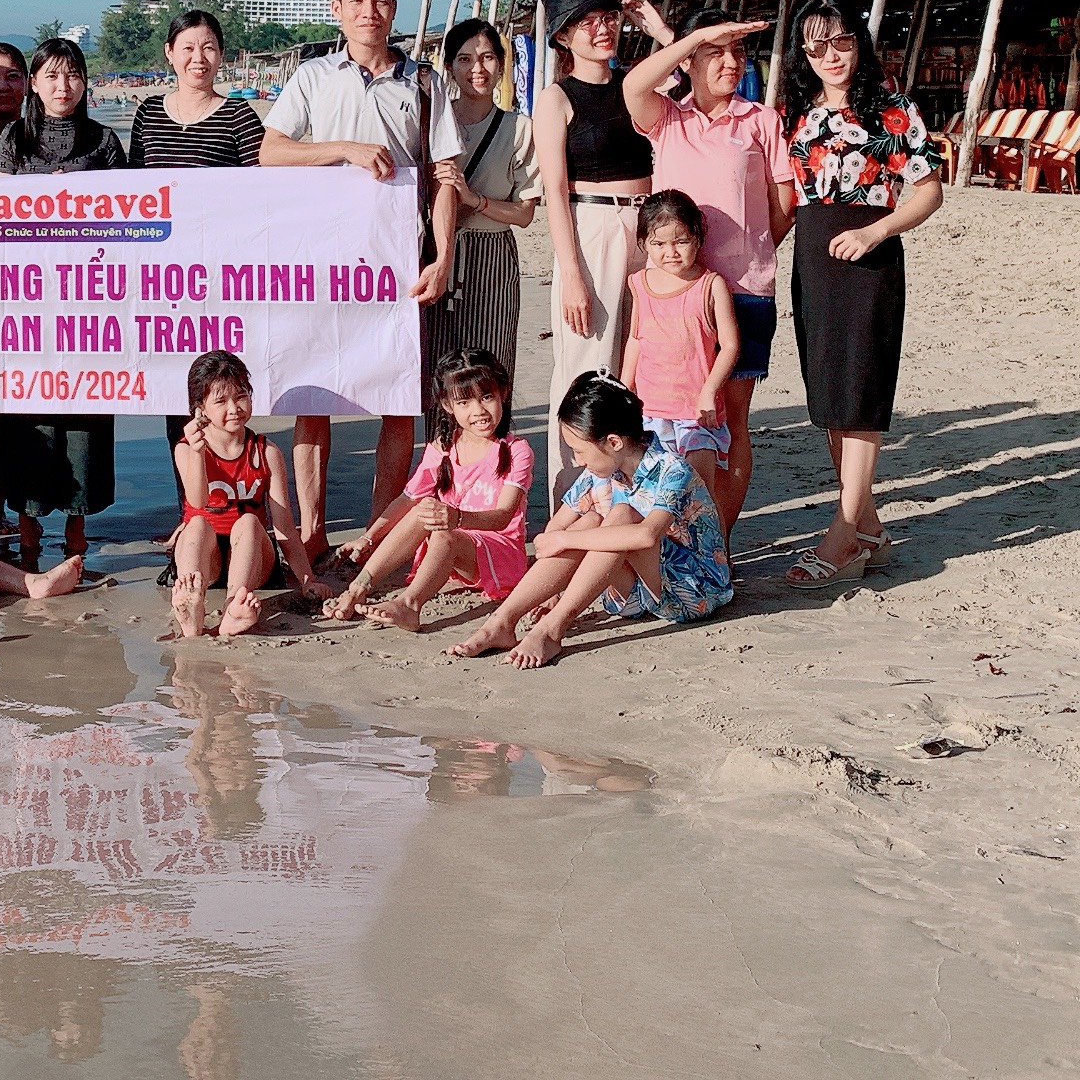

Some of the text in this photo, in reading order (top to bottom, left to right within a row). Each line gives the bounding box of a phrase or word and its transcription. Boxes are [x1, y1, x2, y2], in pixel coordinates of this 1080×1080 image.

[4, 227, 33, 237] Chức
[50, 227, 79, 237] Hành
[80, 227, 122, 238] Chuyên
[124, 227, 164, 239] Nghiệp
[56, 247, 127, 301] TIỂU
[141, 263, 208, 309] HỌC
[222, 264, 315, 302] MINH
[329, 257, 397, 303] HÒA
[56, 315, 122, 352] NHA
[135, 315, 244, 353] TRANG
[0, 369, 147, 400] 13/06/2024
